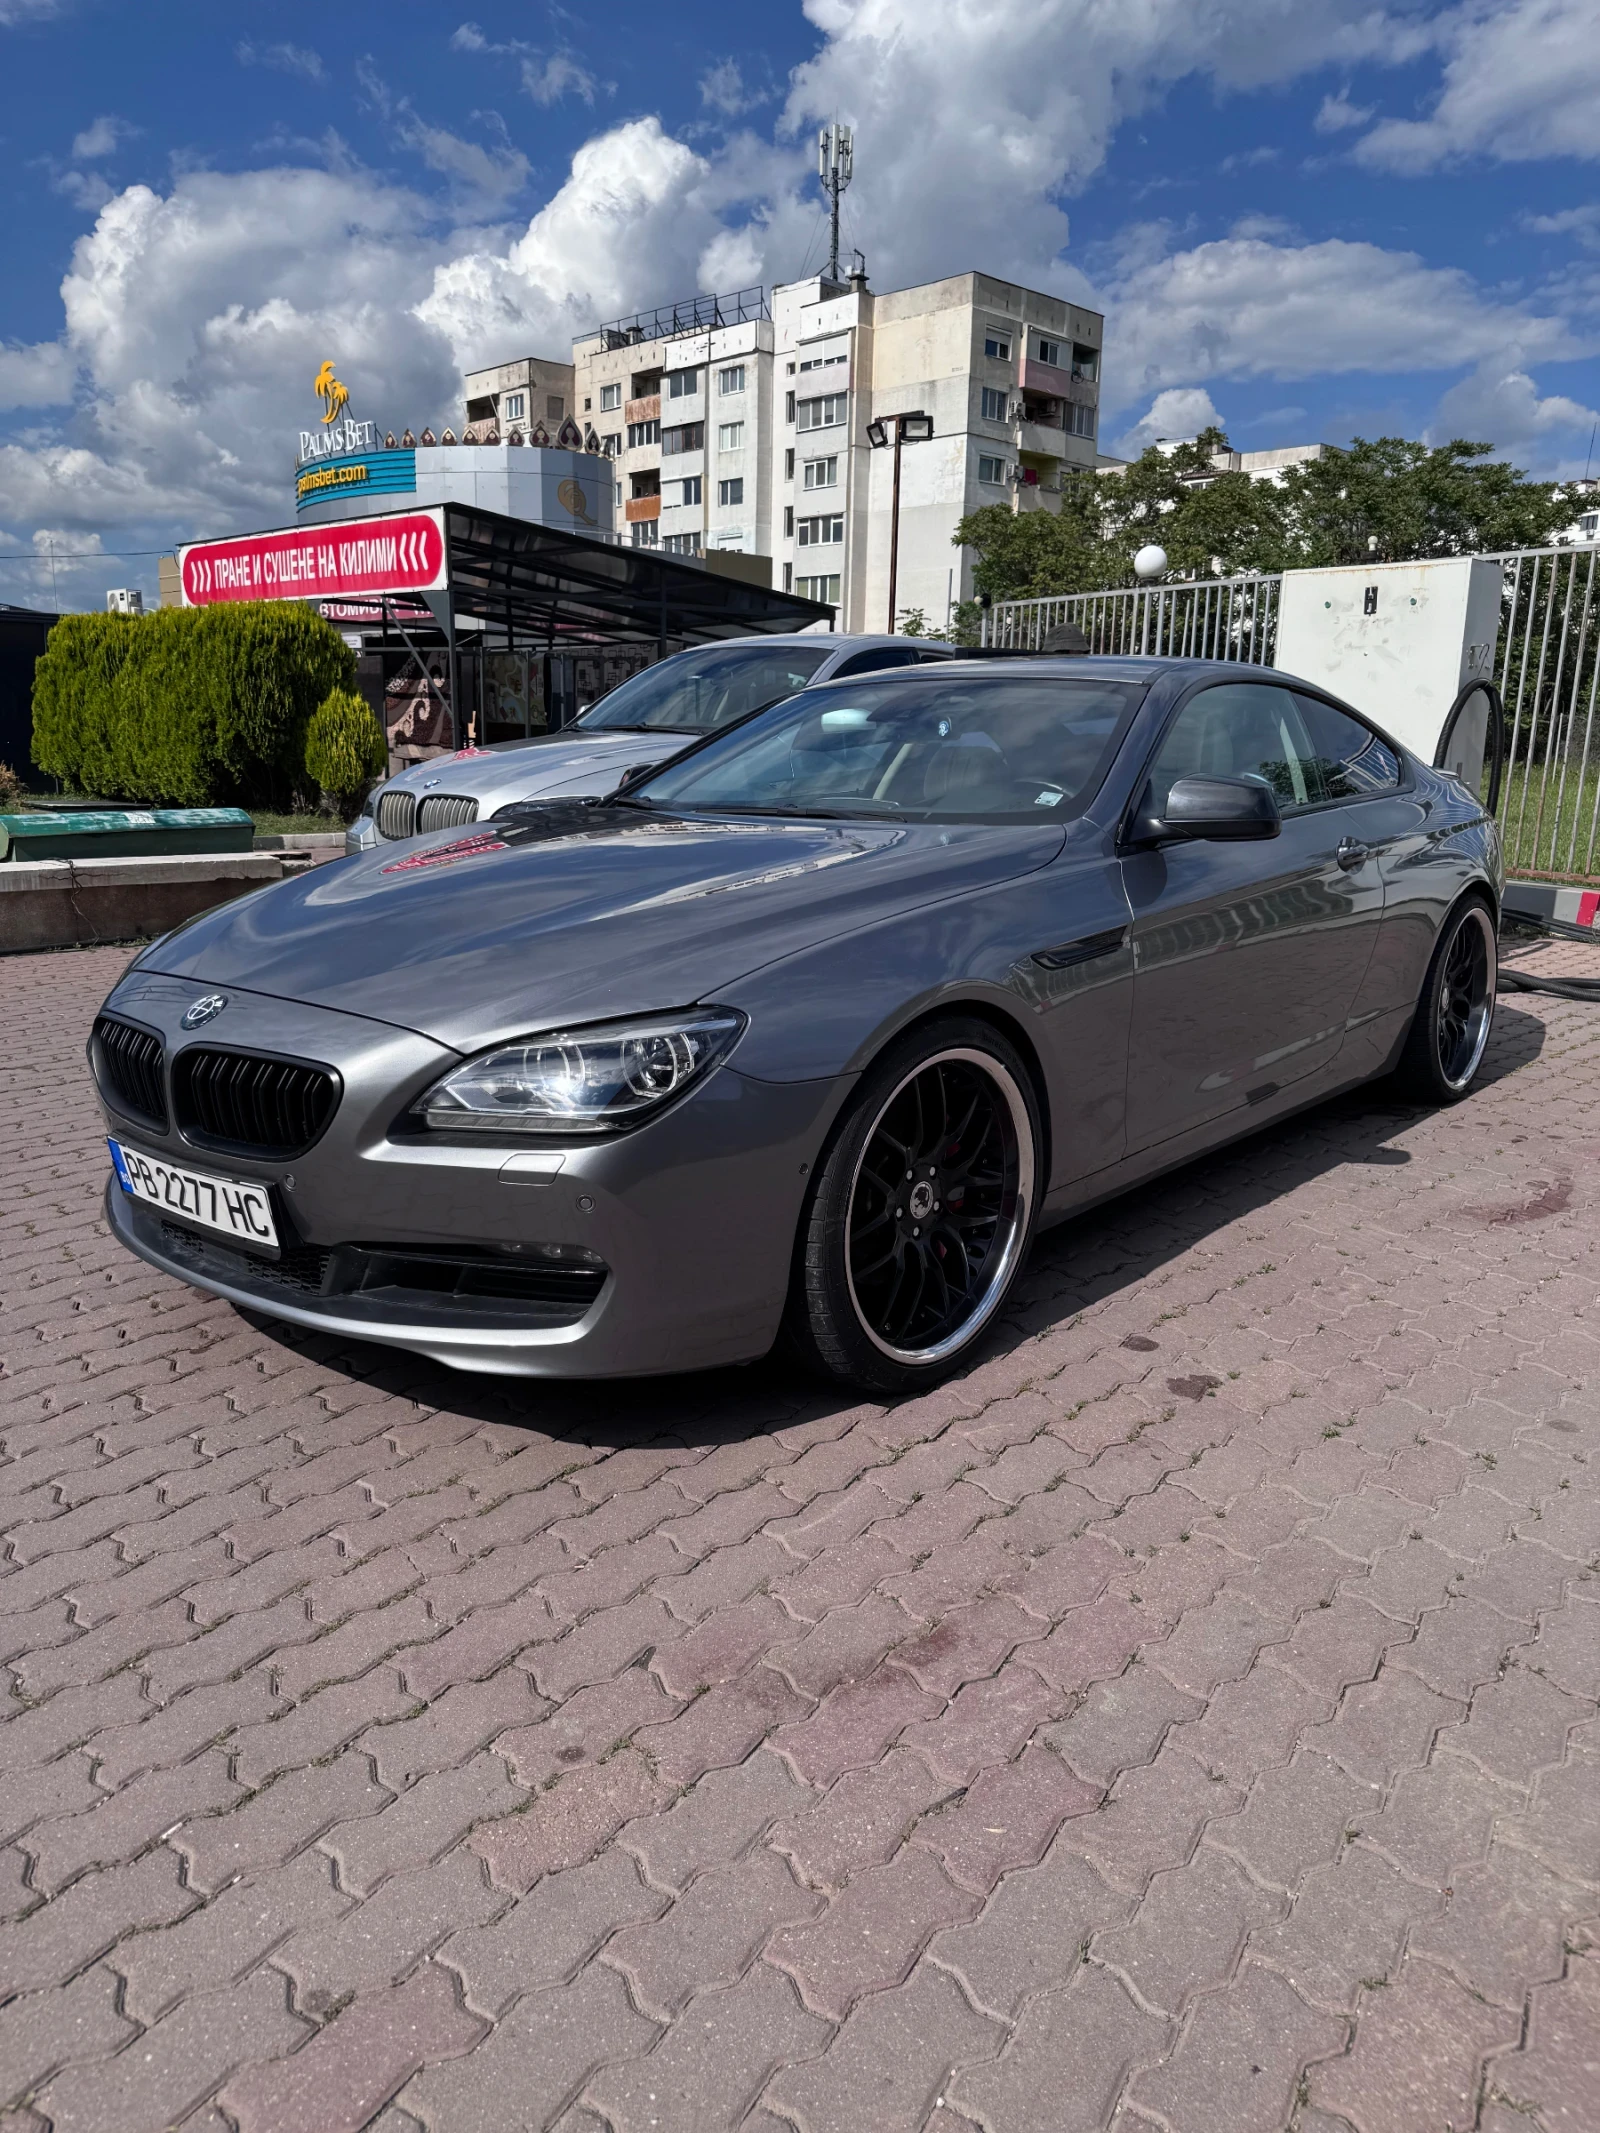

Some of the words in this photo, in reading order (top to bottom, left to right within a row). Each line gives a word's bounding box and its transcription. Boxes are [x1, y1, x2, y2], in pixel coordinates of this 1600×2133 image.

[298, 465, 367, 499] palmsbet.com
[214, 555, 251, 589] ПРАНЕ
[252, 554, 262, 585] И
[263, 547, 315, 584] СУШЕНЕ
[317, 544, 337, 578] НА
[339, 536, 397, 576] КИЛИМИ
